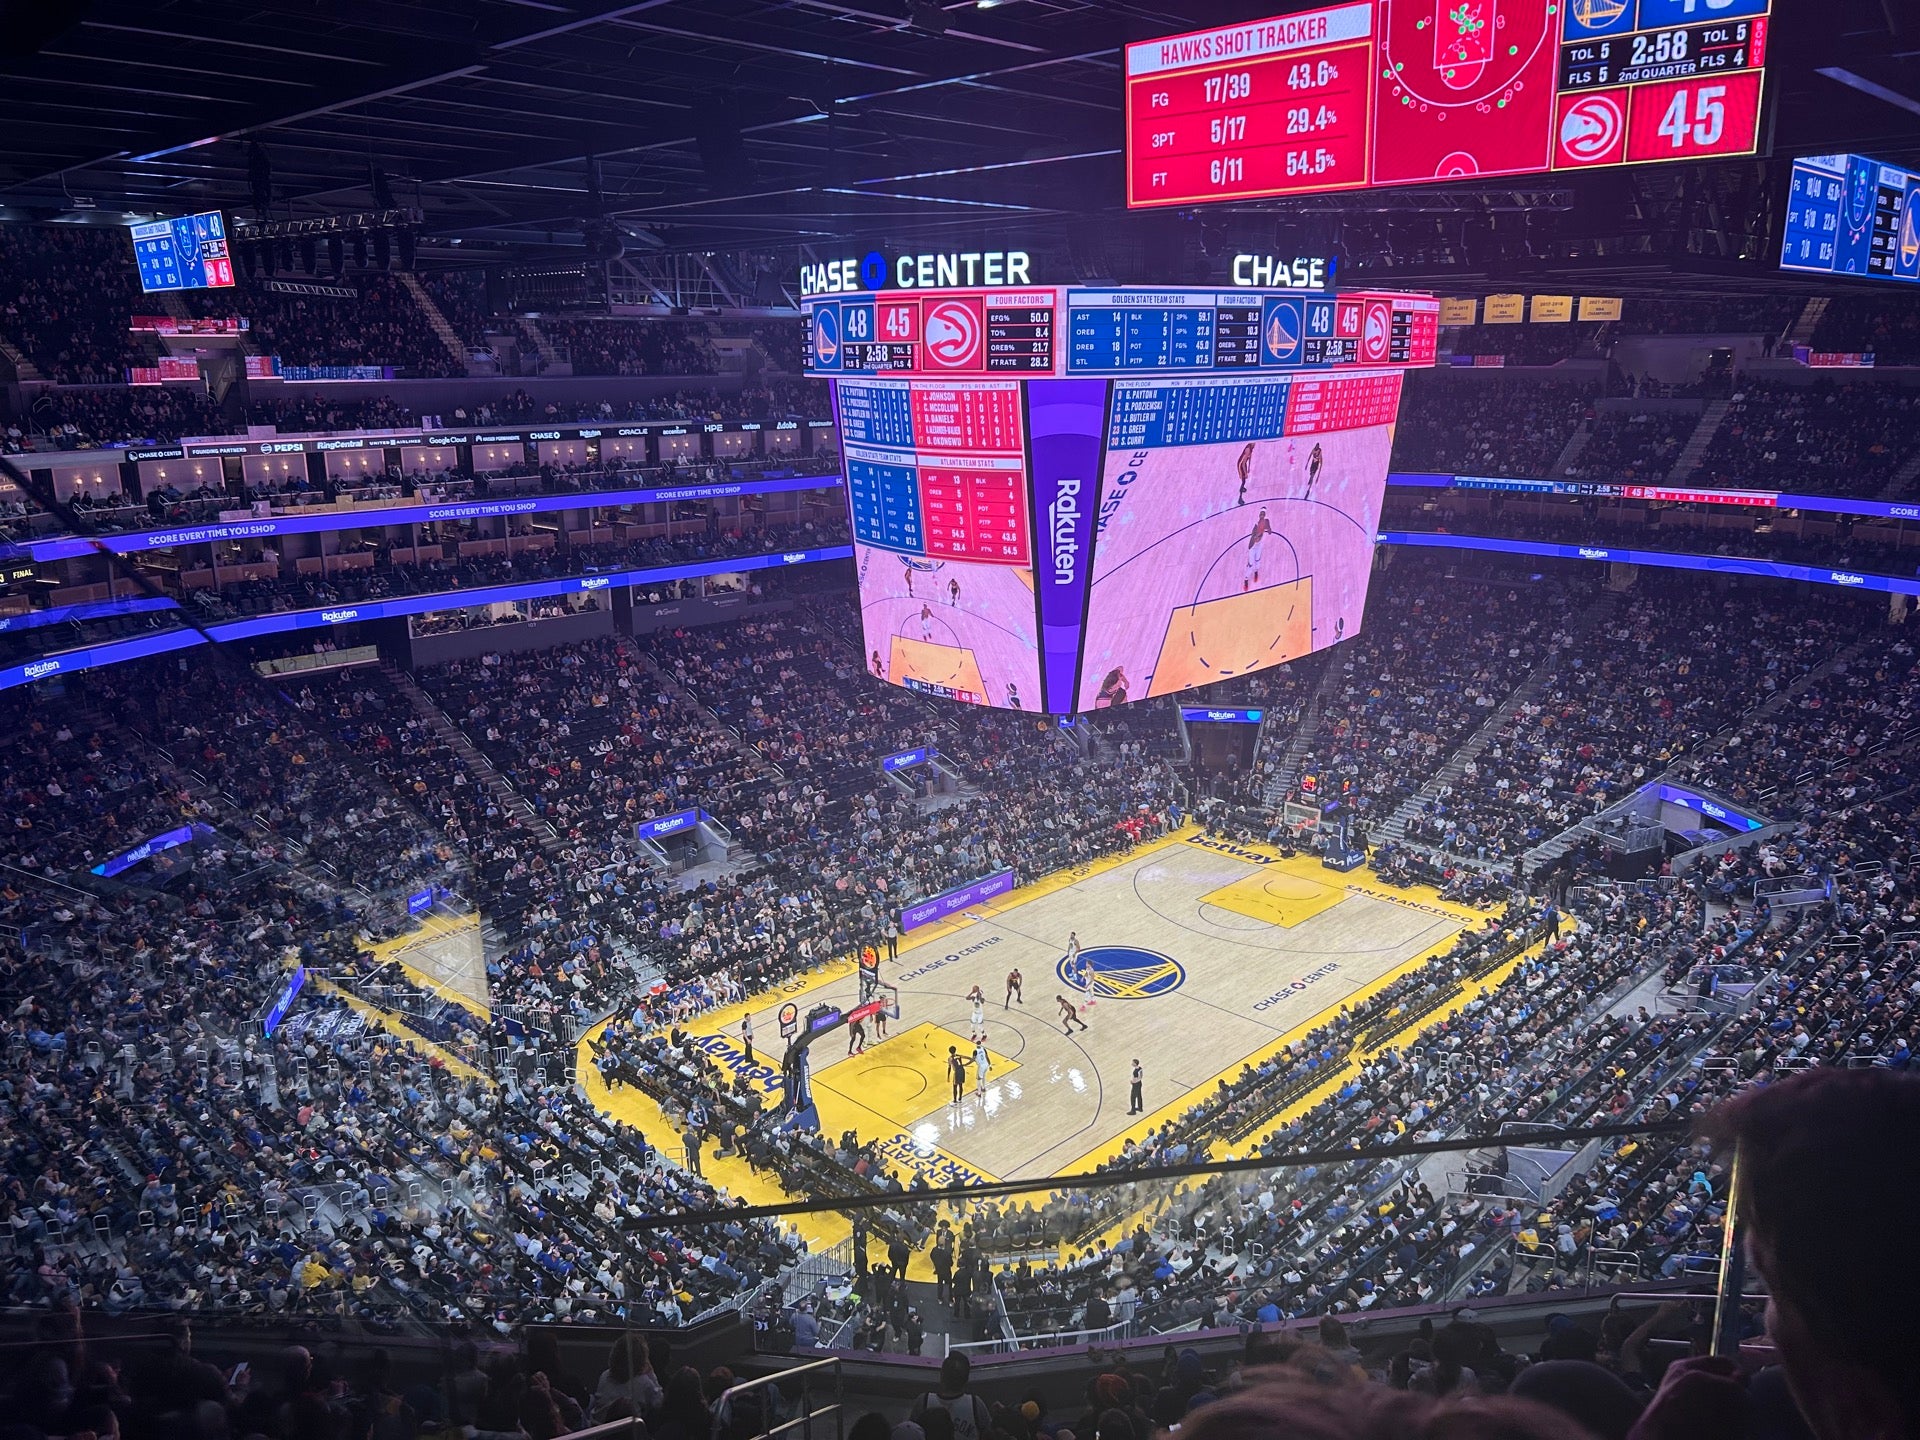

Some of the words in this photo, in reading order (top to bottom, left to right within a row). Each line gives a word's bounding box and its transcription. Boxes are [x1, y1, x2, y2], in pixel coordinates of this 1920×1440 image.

[1703, 30, 1728, 43] TOL
[1736, 24, 1746, 41] 5
[1161, 39, 1211, 65] HAWKS
[1215, 33, 1254, 56] SHOT
[1257, 17, 1327, 49] TRACKER
[1753, 22, 1763, 64] BONUS
[1571, 49, 1594, 61] TOL
[1600, 43, 1609, 58] 5
[1631, 31, 1688, 65] 2:58
[1700, 54, 1725, 68] FLS
[1733, 49, 1744, 66] 4
[1569, 73, 1591, 84] FLS
[1599, 67, 1608, 82] 5
[1618, 67, 1639, 82] 2nd
[1641, 63, 1696, 79] QUARTER
[1152, 93, 1168, 108] FG
[1204, 73, 1251, 103] 17/39
[1288, 60, 1338, 90] 43.6%
[1658, 86, 1726, 148] 45
[1152, 132, 1175, 148] 3PT
[1211, 116, 1246, 145] 5/17
[1286, 106, 1337, 135] 29.4%
[1152, 172, 1168, 187] FT
[1211, 158, 1243, 185] 6/11
[1286, 149, 1335, 176] 54.5%
[210, 216, 220, 236] 48
[219, 262, 229, 282] 45
[800, 259, 858, 295] CHASE
[896, 251, 1031, 288] CENTER
[1233, 254, 1324, 287] CHASE
[995, 296, 1013, 304] FOUR
[1013, 296, 1044, 304] FACTORS
[1112, 296, 1135, 304] GOLDEN
[1136, 296, 1153, 304] STATE
[1154, 296, 1168, 304] TEAM
[1169, 296, 1185, 304] STATS
[848, 309, 867, 338] 48
[886, 308, 910, 337] 45
[1030, 312, 1049, 323] 50.0
[1112, 312, 1121, 322] 14
[1312, 306, 1329, 333] 48
[1342, 306, 1358, 333] 45
[1036, 327, 1049, 338] 8.4
[1116, 326, 1120, 336] 5
[855, 346, 859, 355] 5
[893, 346, 905, 354] TOL
[907, 345, 912, 355] 5
[1032, 342, 1049, 352] 21.7
[1112, 341, 1120, 351] 18
[1326, 340, 1343, 356] 2:58
[866, 345, 888, 362] 2:58
[855, 359, 860, 369] 5
[907, 360, 912, 369] 4
[1030, 357, 1049, 367] 28.2
[1115, 356, 1119, 366] 3
[929, 392, 955, 400] JOHNSON
[1132, 390, 1153, 399] PAYTON
[1130, 401, 1162, 411] PODZIEMSKI
[931, 415, 954, 424] DANIELS
[1130, 414, 1149, 422] BUTLER
[1129, 425, 1146, 433] GREEN
[317, 440, 363, 450] RingCentral
[429, 437, 450, 445] Google
[1127, 436, 1144, 445] CURRY
[677, 490, 696, 498] EVERY
[1632, 488, 1641, 496] 45
[429, 509, 455, 518] SCORE
[456, 508, 480, 516] EVERY
[1890, 507, 1918, 517] SCORE
[149, 534, 178, 545] SCORE
[179, 531, 206, 541] EVERY
[207, 528, 227, 538] TIME
[229, 527, 248, 536] YOU
[250, 524, 276, 534] SHOP
[1054, 479, 1080, 585] Rakuten
[783, 553, 806, 562] Rakuten
[1579, 548, 1608, 559] Rakuten
[13, 569, 33, 579] FINAL
[1832, 573, 1863, 584] Rakuten
[581, 578, 609, 588] Rakuten
[322, 610, 357, 622] Rakuten
[24, 661, 60, 677] Rakuten
[1207, 710, 1235, 720] Rakuten
[894, 752, 916, 766] Rakuten
[1303, 781, 1315, 792] 24
[1702, 801, 1726, 818] Rakuten
[654, 817, 684, 832] Rakuten
[1185, 834, 1282, 865] betway
[980, 880, 1003, 896] Rakuten
[946, 893, 971, 909] Rakuten
[1344, 884, 1375, 897] SAN
[1387, 894, 1474, 923] FRANCISCO
[912, 905, 937, 922] Rakuten
[899, 959, 947, 983] CHASE
[958, 935, 1004, 957] CENTER
[1253, 987, 1295, 1012] CHASE
[1303, 962, 1341, 985] CENTER
